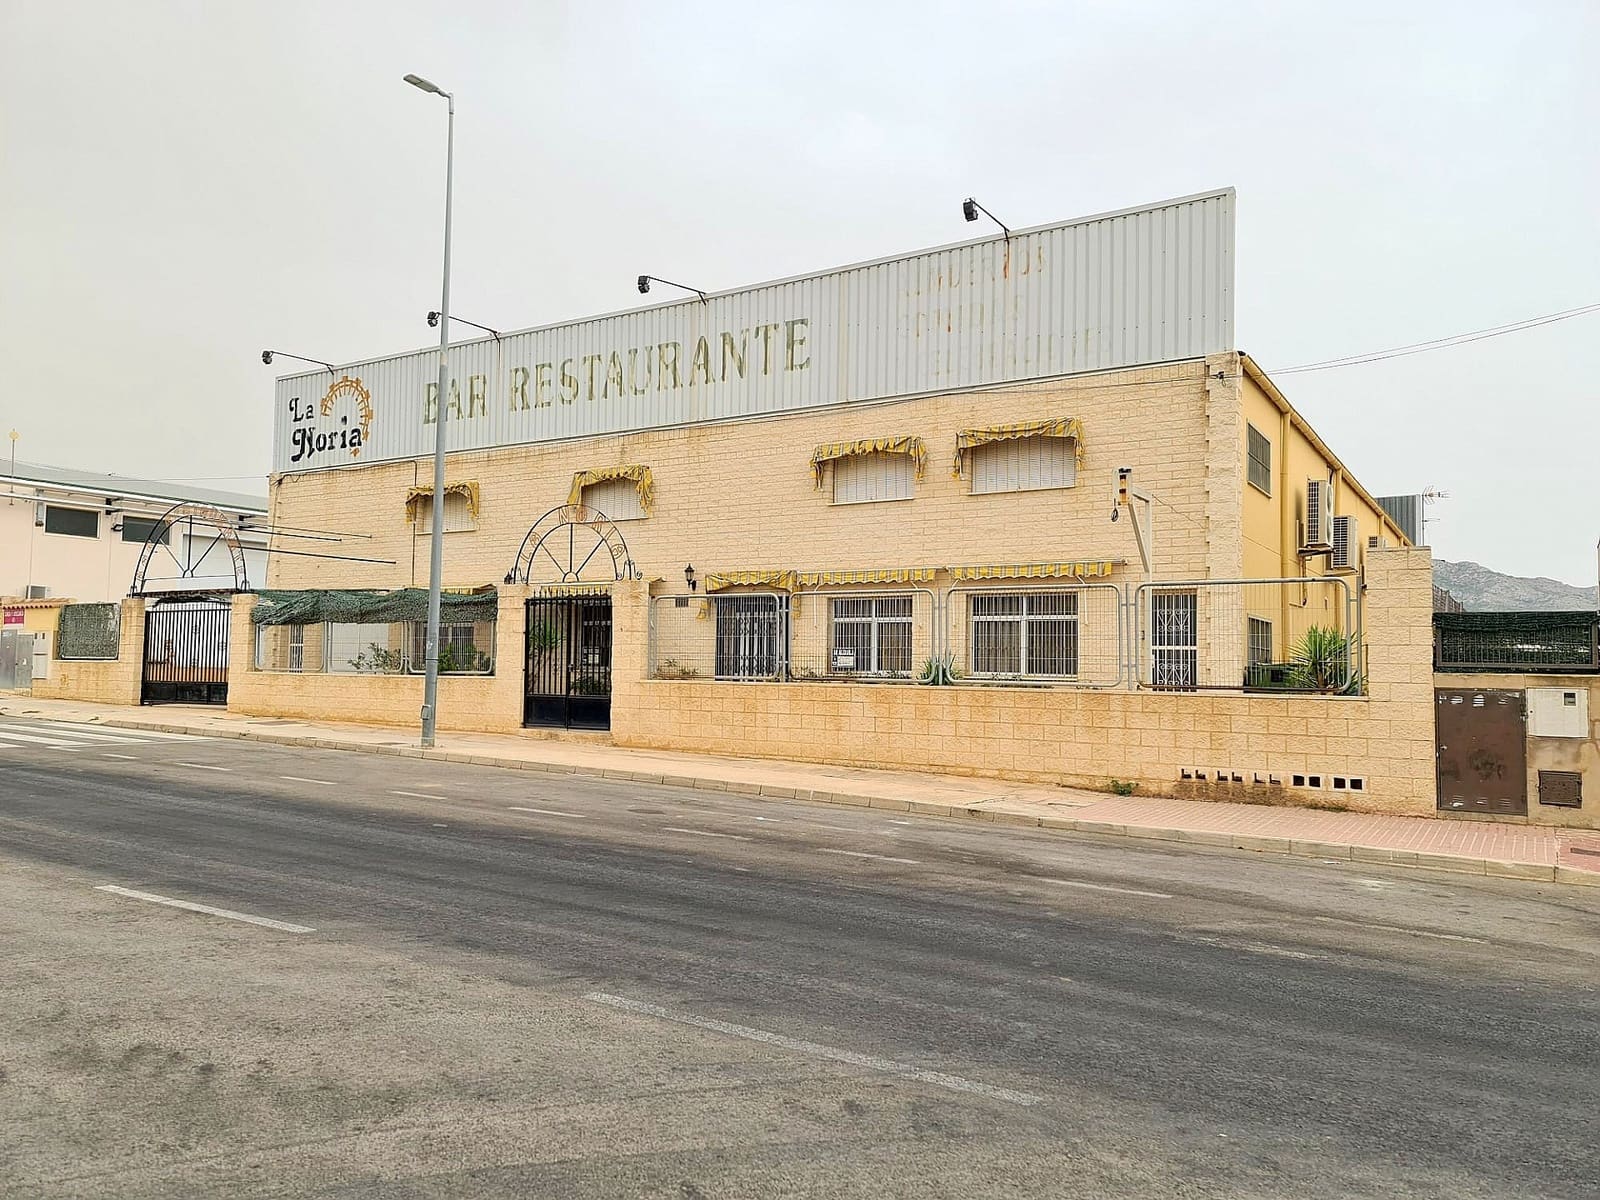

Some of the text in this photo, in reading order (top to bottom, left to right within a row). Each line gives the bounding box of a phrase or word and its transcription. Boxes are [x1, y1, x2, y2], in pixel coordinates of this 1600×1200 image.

[423, 373, 488, 425] BAR
[509, 318, 811, 413] RESTAURANTE
[289, 397, 314, 423] La
[291, 415, 362, 462] Noria
